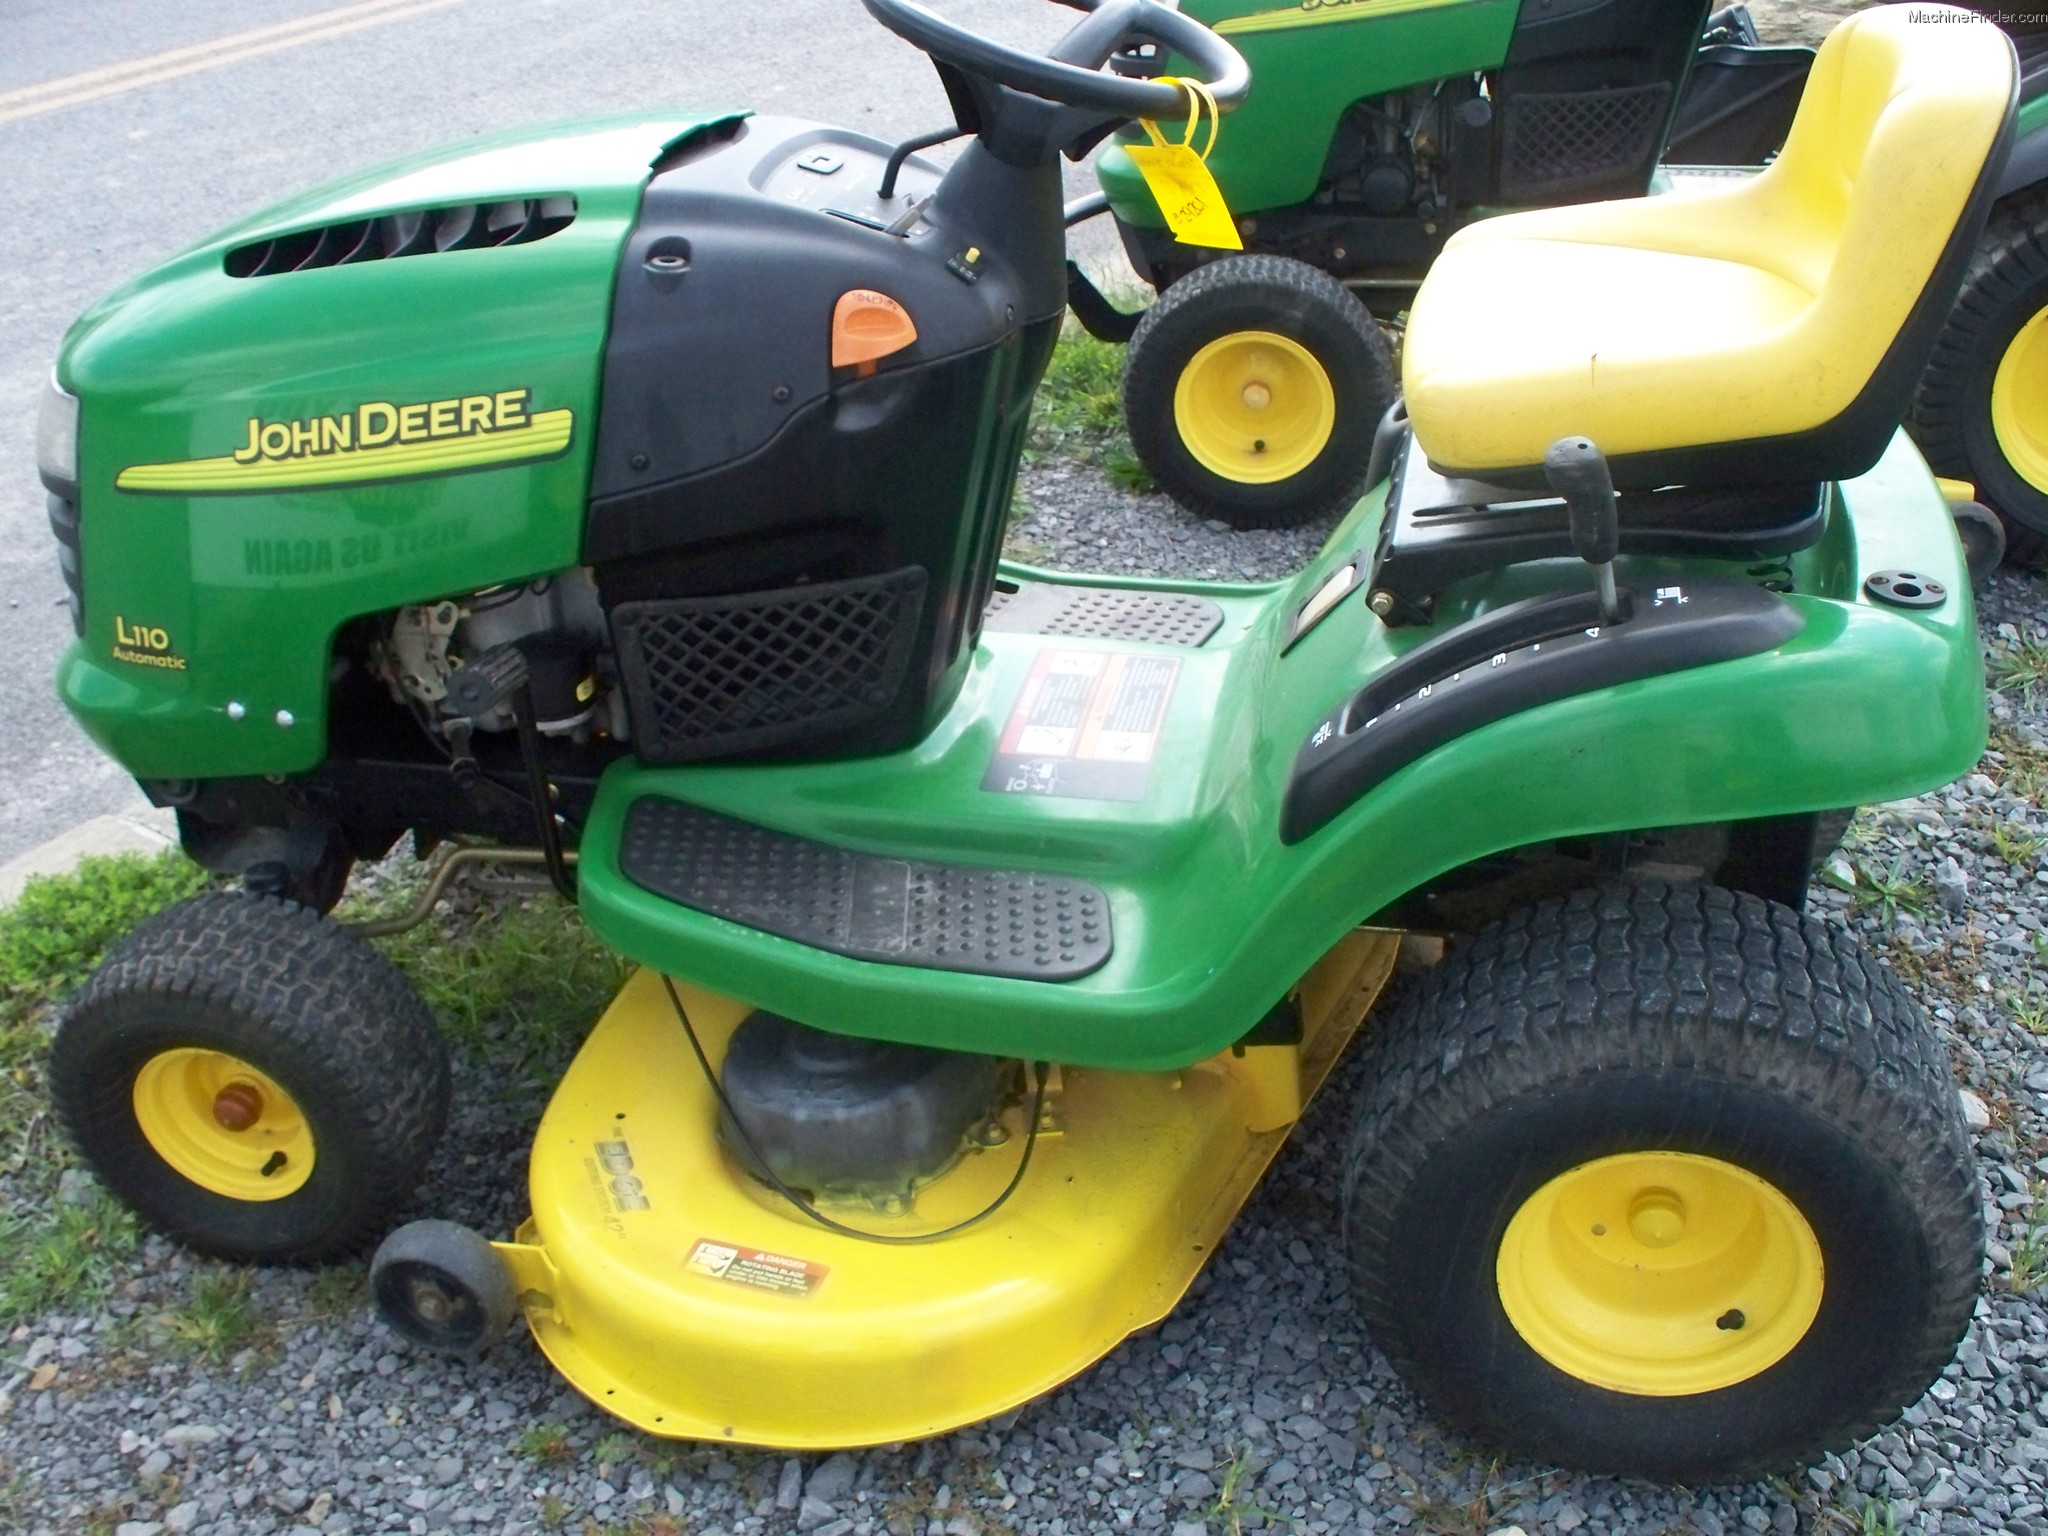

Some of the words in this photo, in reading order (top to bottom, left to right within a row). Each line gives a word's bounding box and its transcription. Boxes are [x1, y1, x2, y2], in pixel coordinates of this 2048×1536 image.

[234, 413, 352, 463] JOHN
[358, 388, 528, 447] DEERE
[112, 645, 187, 670] Automatic
[115, 614, 170, 650] L110
[1418, 683, 1432, 699] 2
[1491, 652, 1507, 668] 3
[1585, 626, 1600, 639] 4
[594, 1140, 651, 1212] EDGE
[766, 1255, 807, 1269] DANGER
